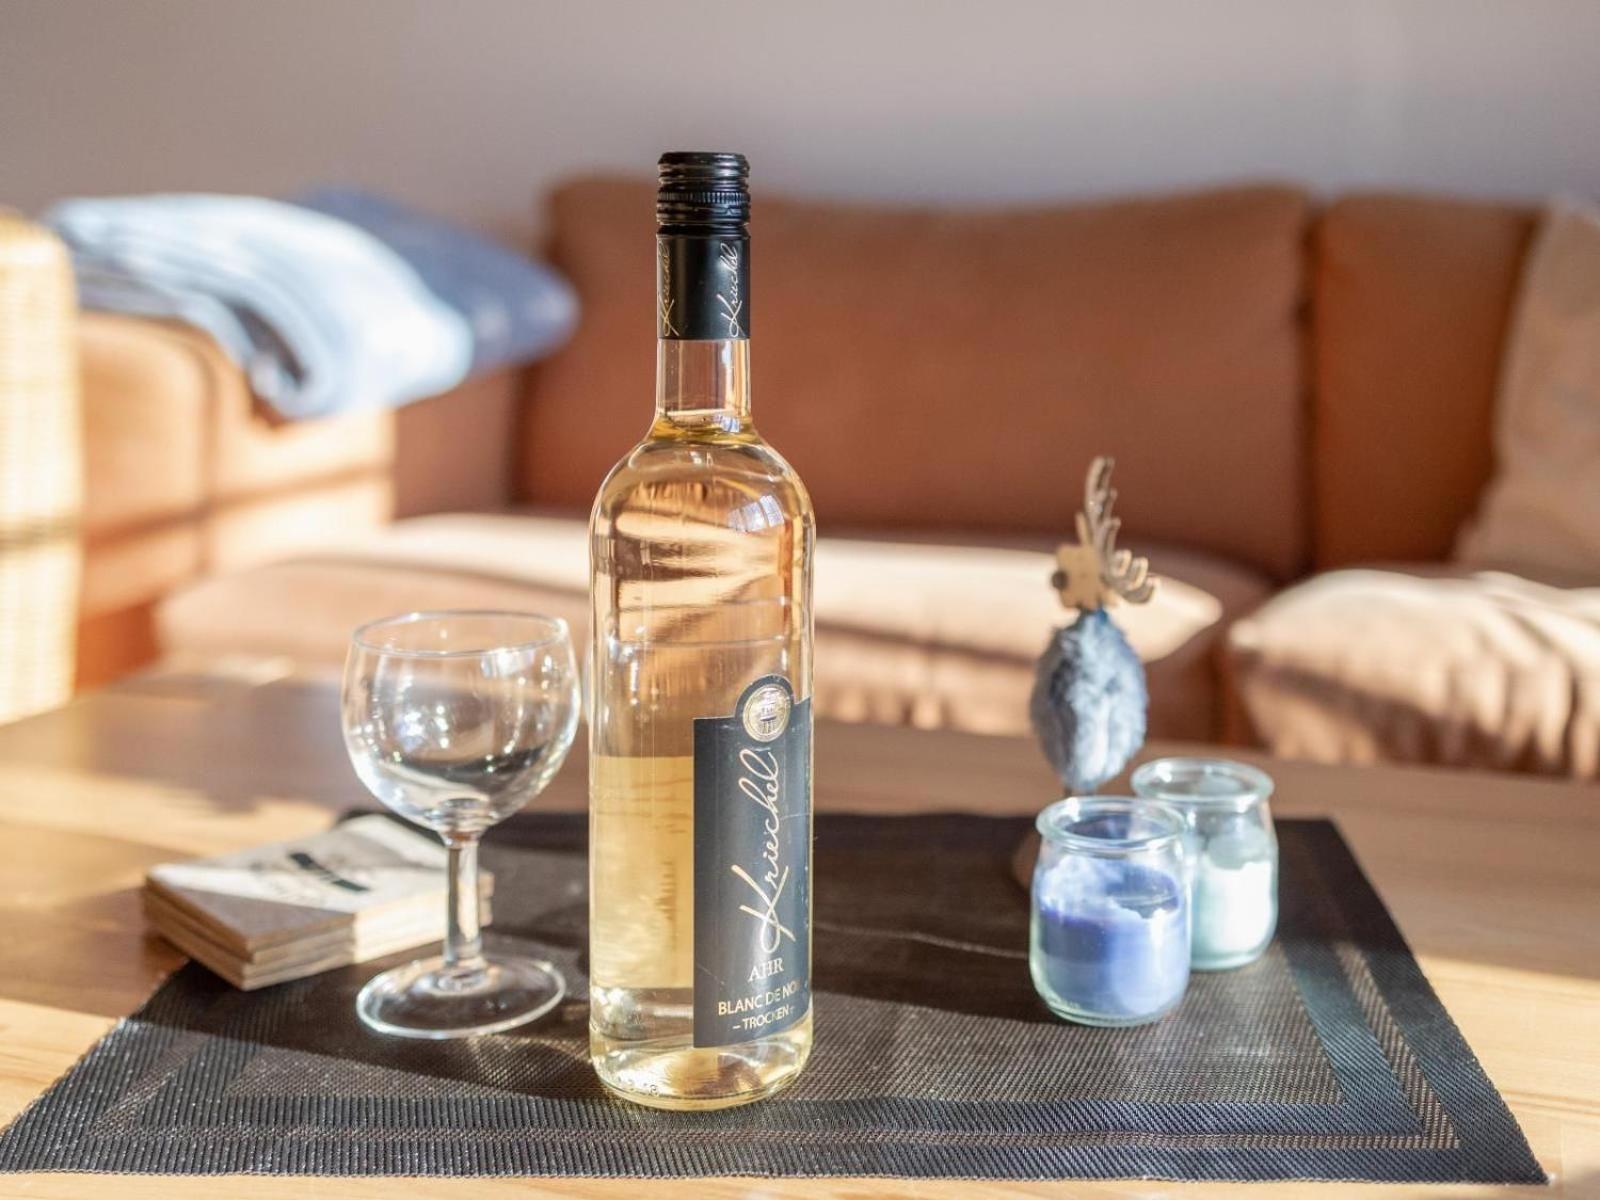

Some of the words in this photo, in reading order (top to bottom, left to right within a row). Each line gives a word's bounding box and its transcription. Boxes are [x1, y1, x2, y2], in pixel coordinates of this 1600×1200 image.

[731, 749, 796, 953] Kriechel
[748, 957, 784, 983] AHR
[718, 994, 762, 1016] BLANC
[765, 988, 781, 1005] DE
[742, 1004, 789, 1030] TROCKEN
